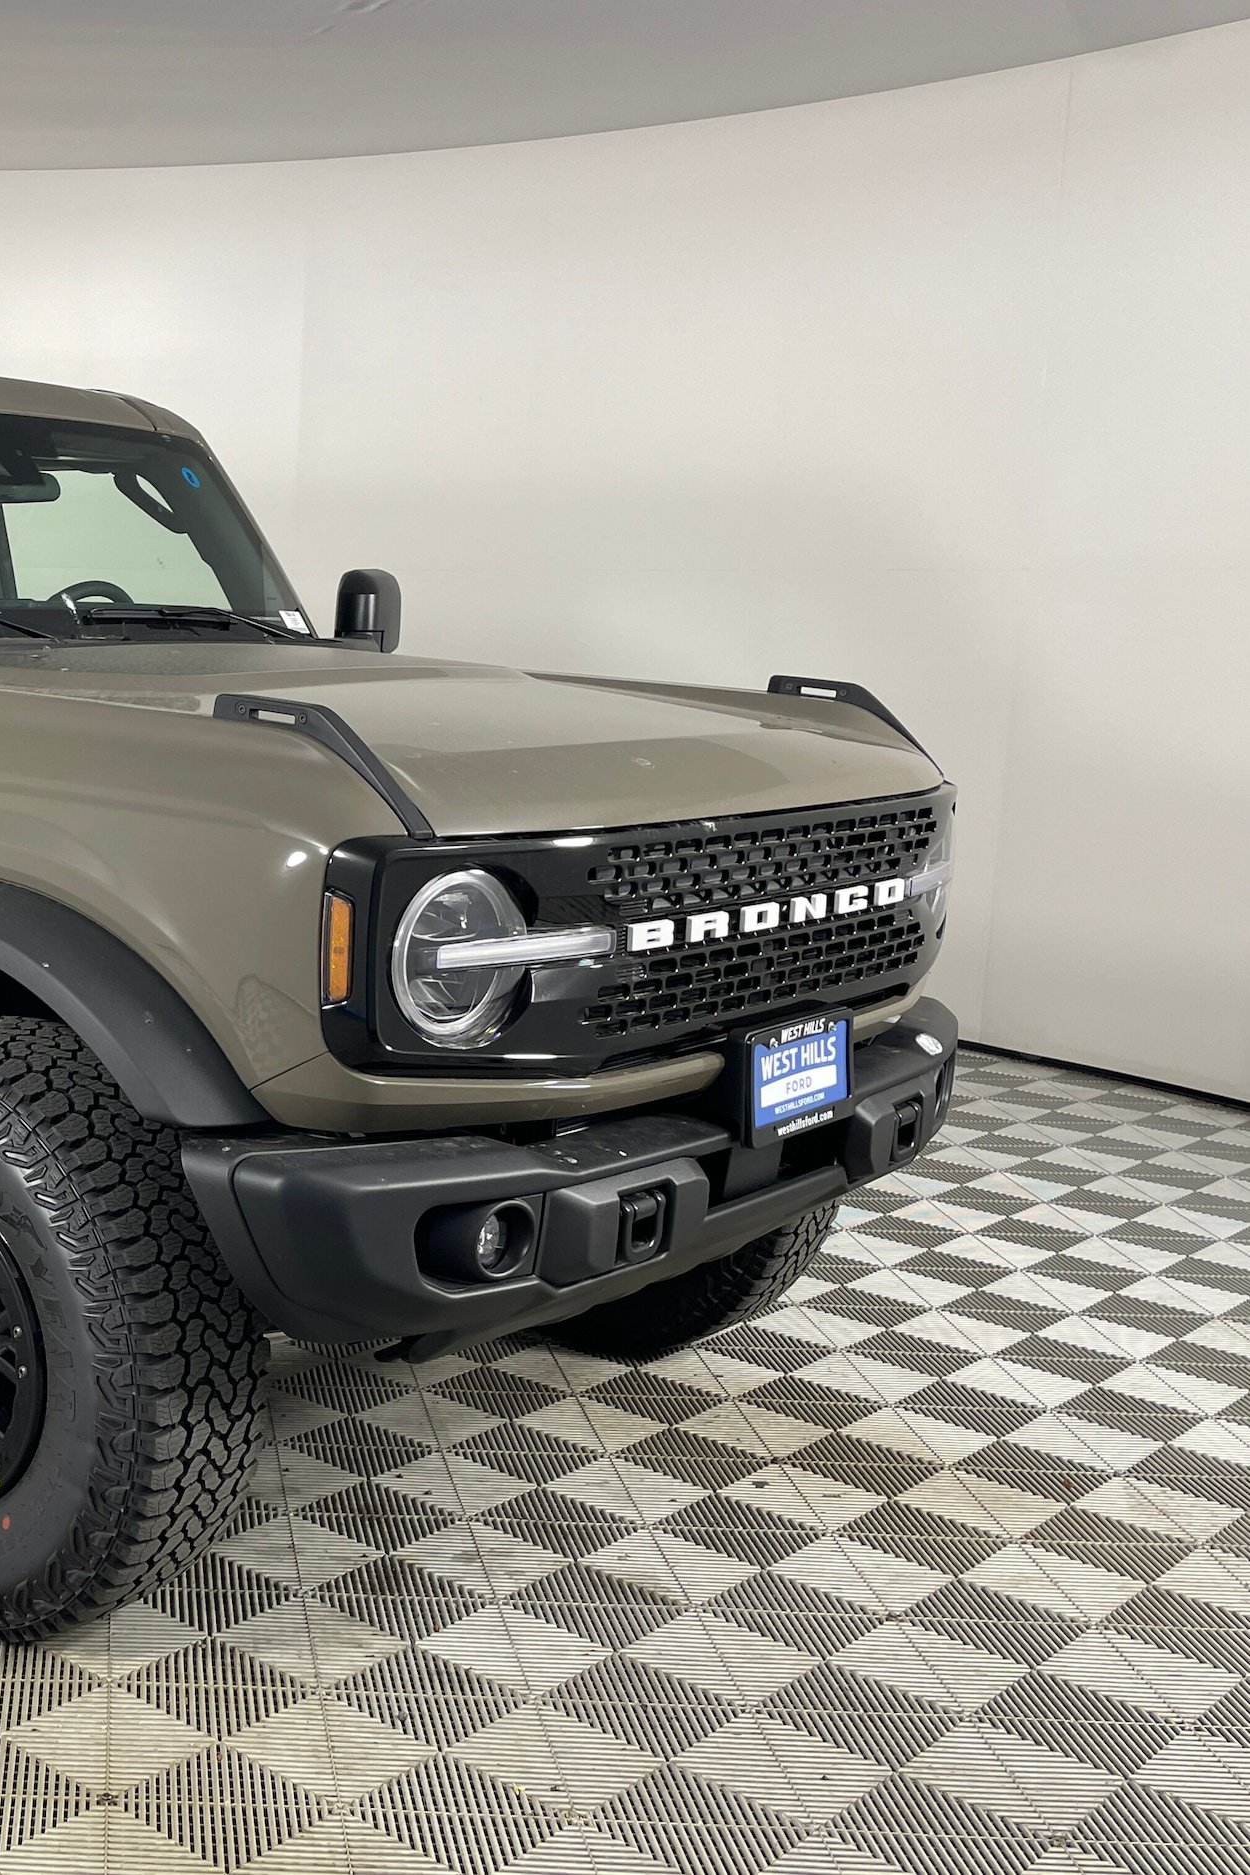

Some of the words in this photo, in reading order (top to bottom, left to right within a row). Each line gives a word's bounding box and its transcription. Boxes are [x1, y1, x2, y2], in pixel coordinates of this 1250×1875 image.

[627, 877, 906, 952] BRONCO
[780, 1025, 802, 1043] WEST
[803, 1018, 826, 1036] HILLS
[761, 1047, 798, 1081] WEST
[801, 1036, 837, 1067] HILLS
[786, 1076, 812, 1094] FORD
[774, 1092, 825, 1115] WESTHILLSFORD.COM
[777, 1110, 834, 1136] westhillsford.com
